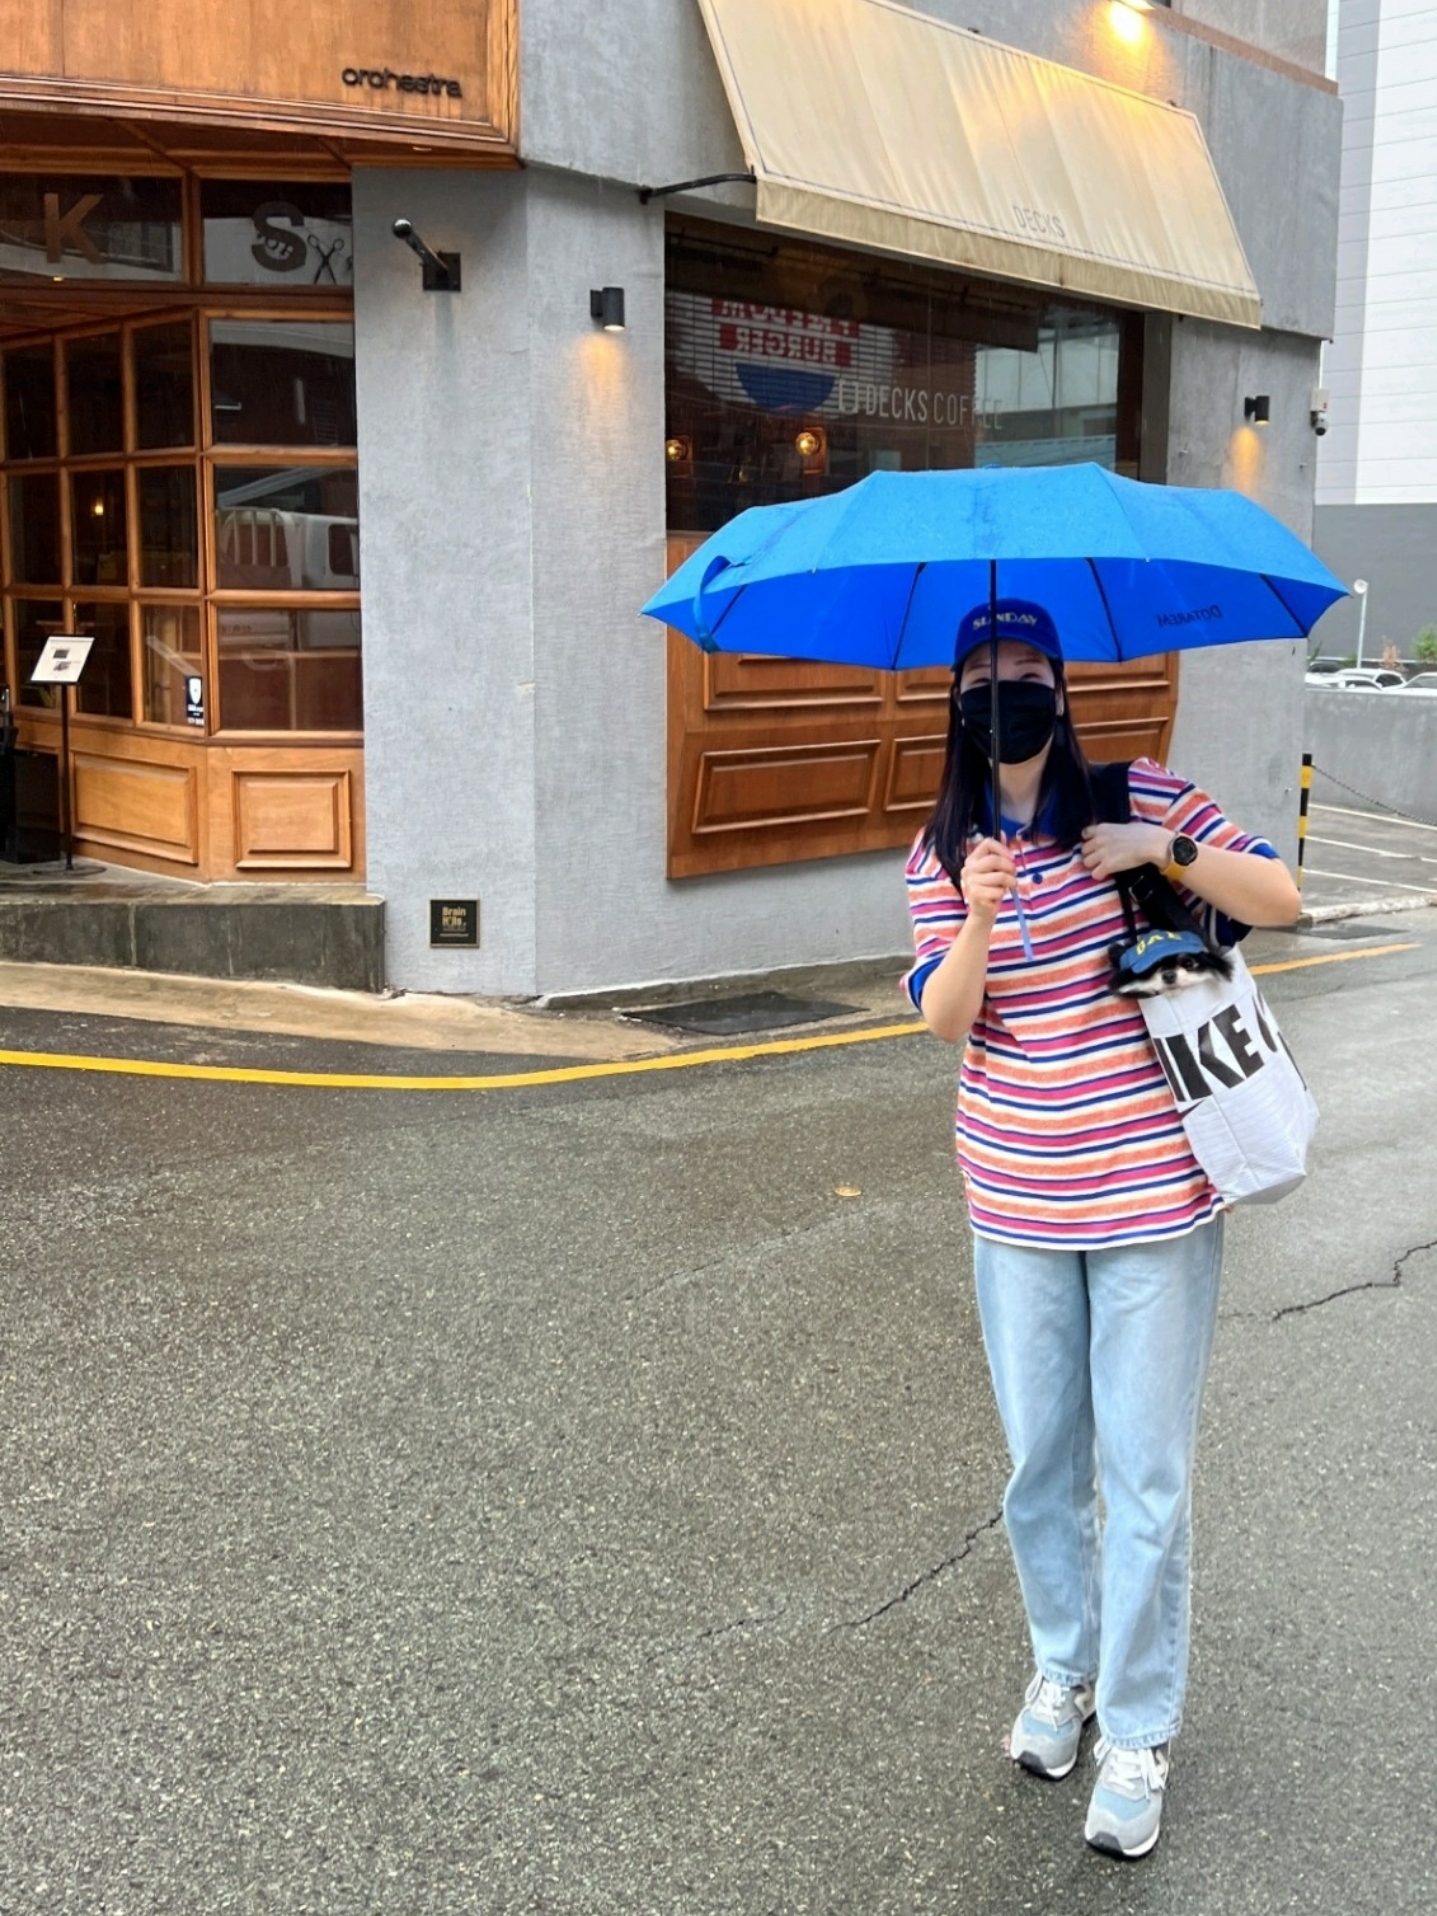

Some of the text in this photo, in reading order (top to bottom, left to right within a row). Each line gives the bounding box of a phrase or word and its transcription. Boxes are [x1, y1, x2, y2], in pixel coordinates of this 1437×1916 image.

[342, 67, 462, 98] orchestra
[44, 192, 107, 265] K
[1012, 205, 1065, 238] DECKS
